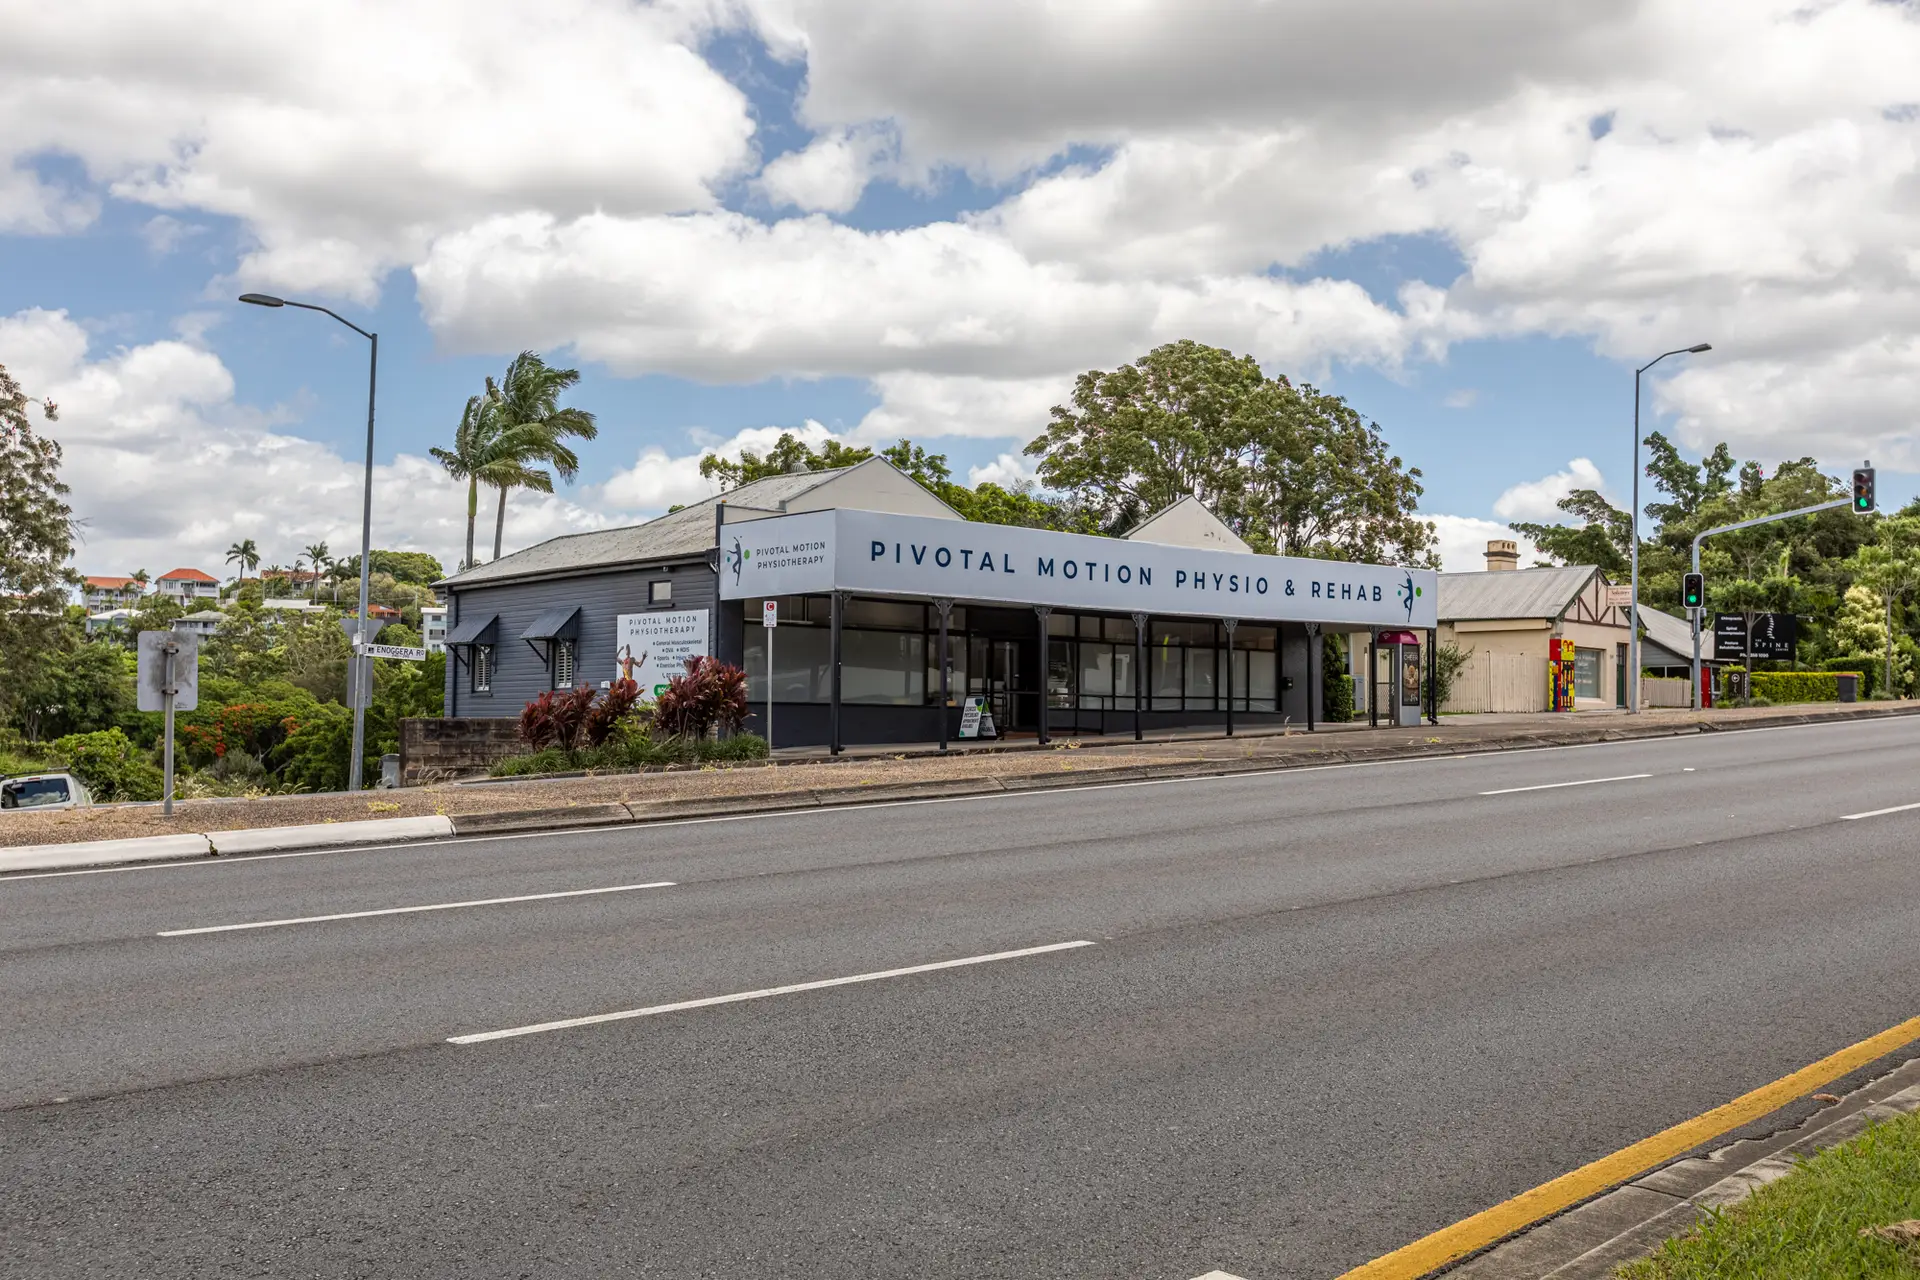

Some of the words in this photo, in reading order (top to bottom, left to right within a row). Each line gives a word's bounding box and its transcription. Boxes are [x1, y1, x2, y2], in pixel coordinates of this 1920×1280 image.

[756, 546, 789, 557] PIVOTAL
[792, 541, 826, 553] MOTION
[757, 555, 825, 570] PHYSIOTHERAPY
[871, 540, 1016, 574] PIVOTAL
[1037, 556, 1152, 586] MOTION
[1175, 570, 1269, 595] PHYSIO
[1284, 579, 1296, 596] &
[1311, 581, 1383, 602] REHAB
[629, 617, 661, 626] PIVOTAL
[665, 615, 697, 624] MOTION
[630, 625, 696, 636] PHYSIOTHERAPY
[376, 646, 414, 656] ENOGGERA
[416, 649, 425, 657] RD
